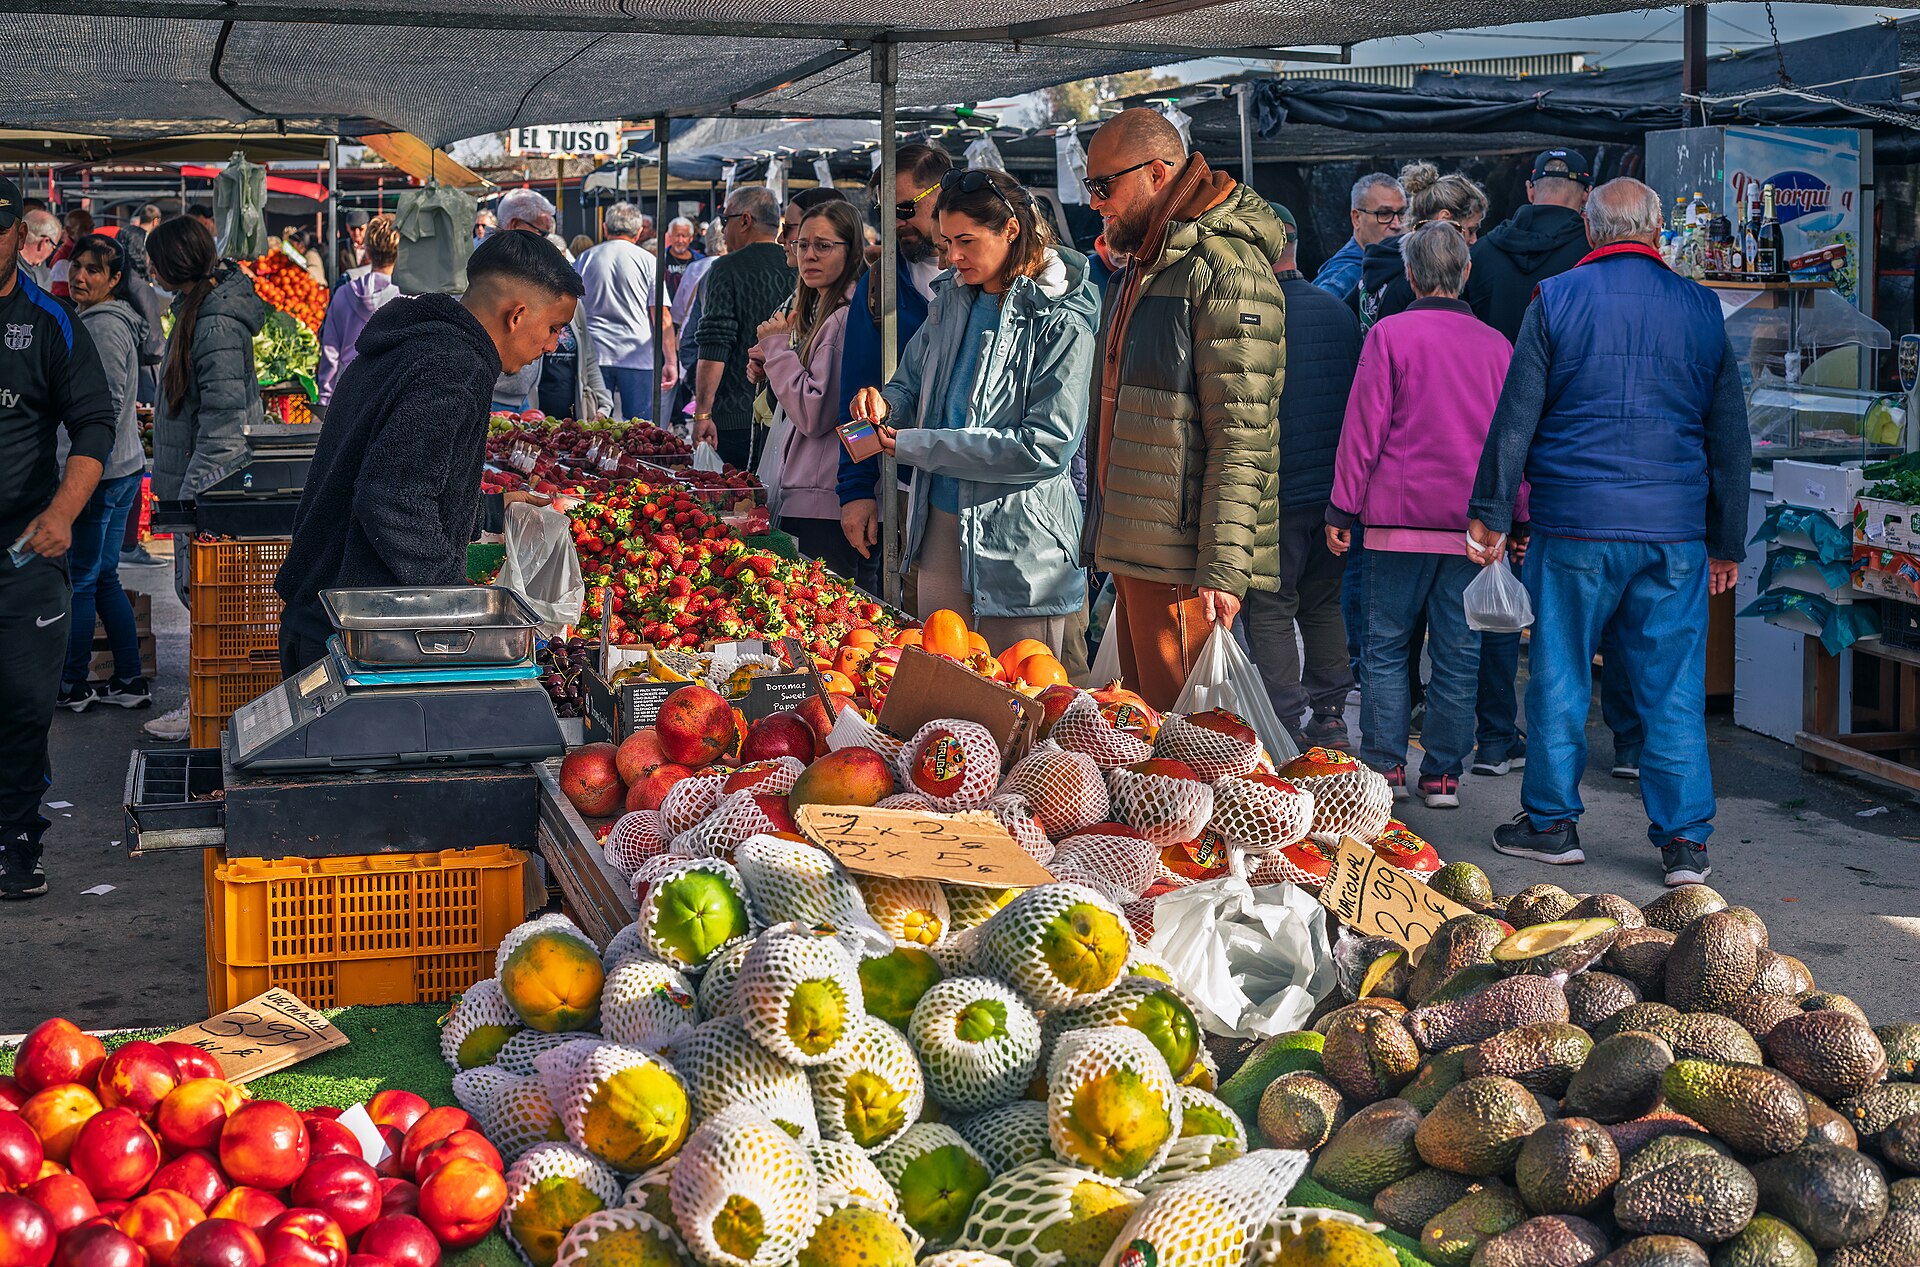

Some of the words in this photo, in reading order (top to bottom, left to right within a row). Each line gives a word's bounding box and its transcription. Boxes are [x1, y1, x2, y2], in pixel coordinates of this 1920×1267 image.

[519, 128, 540, 148] EL
[548, 130, 609, 151] TUSO
[765, 682, 806, 691] Doramas
[781, 691, 806, 701] Sweet
[936, 741, 947, 775] ARUBA
[912, 821, 960, 843] 3
[838, 844, 876, 862] 2
[931, 851, 973, 868] 5
